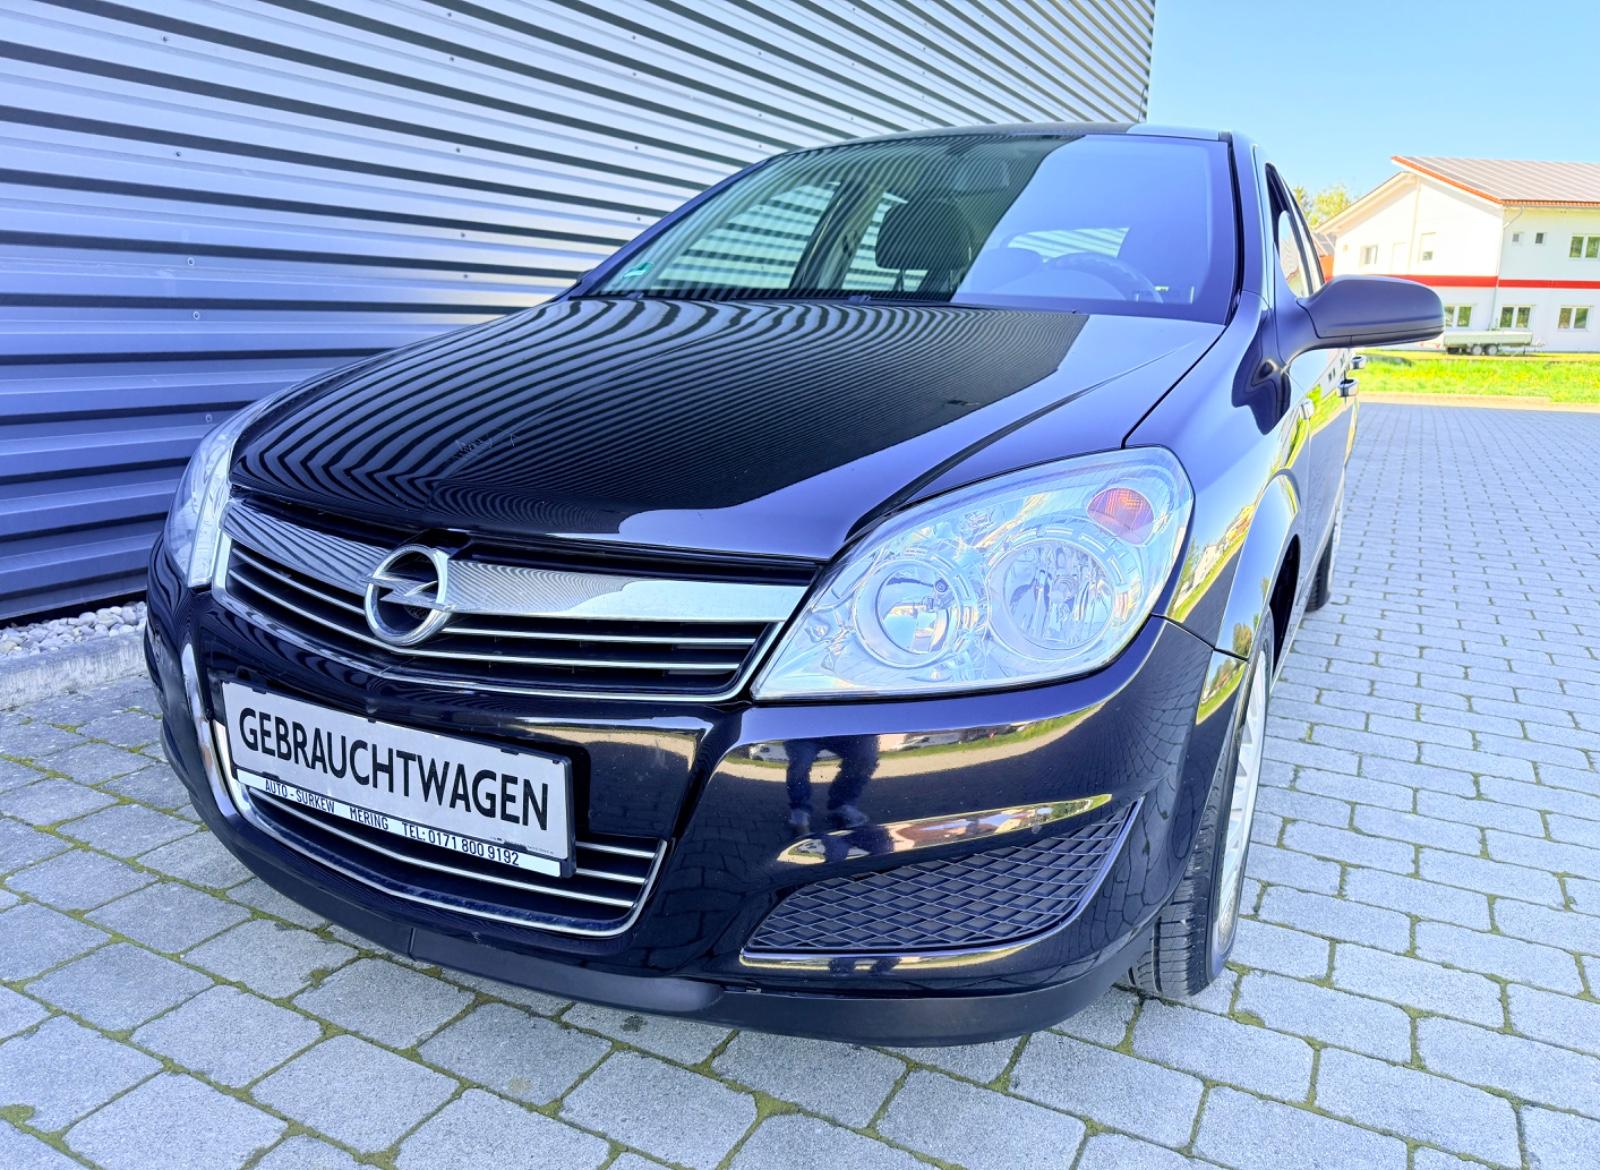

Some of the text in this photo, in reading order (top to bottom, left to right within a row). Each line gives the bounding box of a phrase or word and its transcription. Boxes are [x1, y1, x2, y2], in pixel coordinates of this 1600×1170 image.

[239, 707, 549, 831] GEBRAUCHTWAGEN
[265, 779, 288, 799] AUTO
[296, 789, 335, 813] SURKEW
[350, 806, 389, 830] MERING
[402, 822, 426, 841] TEL:
[428, 829, 457, 850] 0171
[461, 838, 485, 858] 800
[488, 845, 519, 866] 9192
